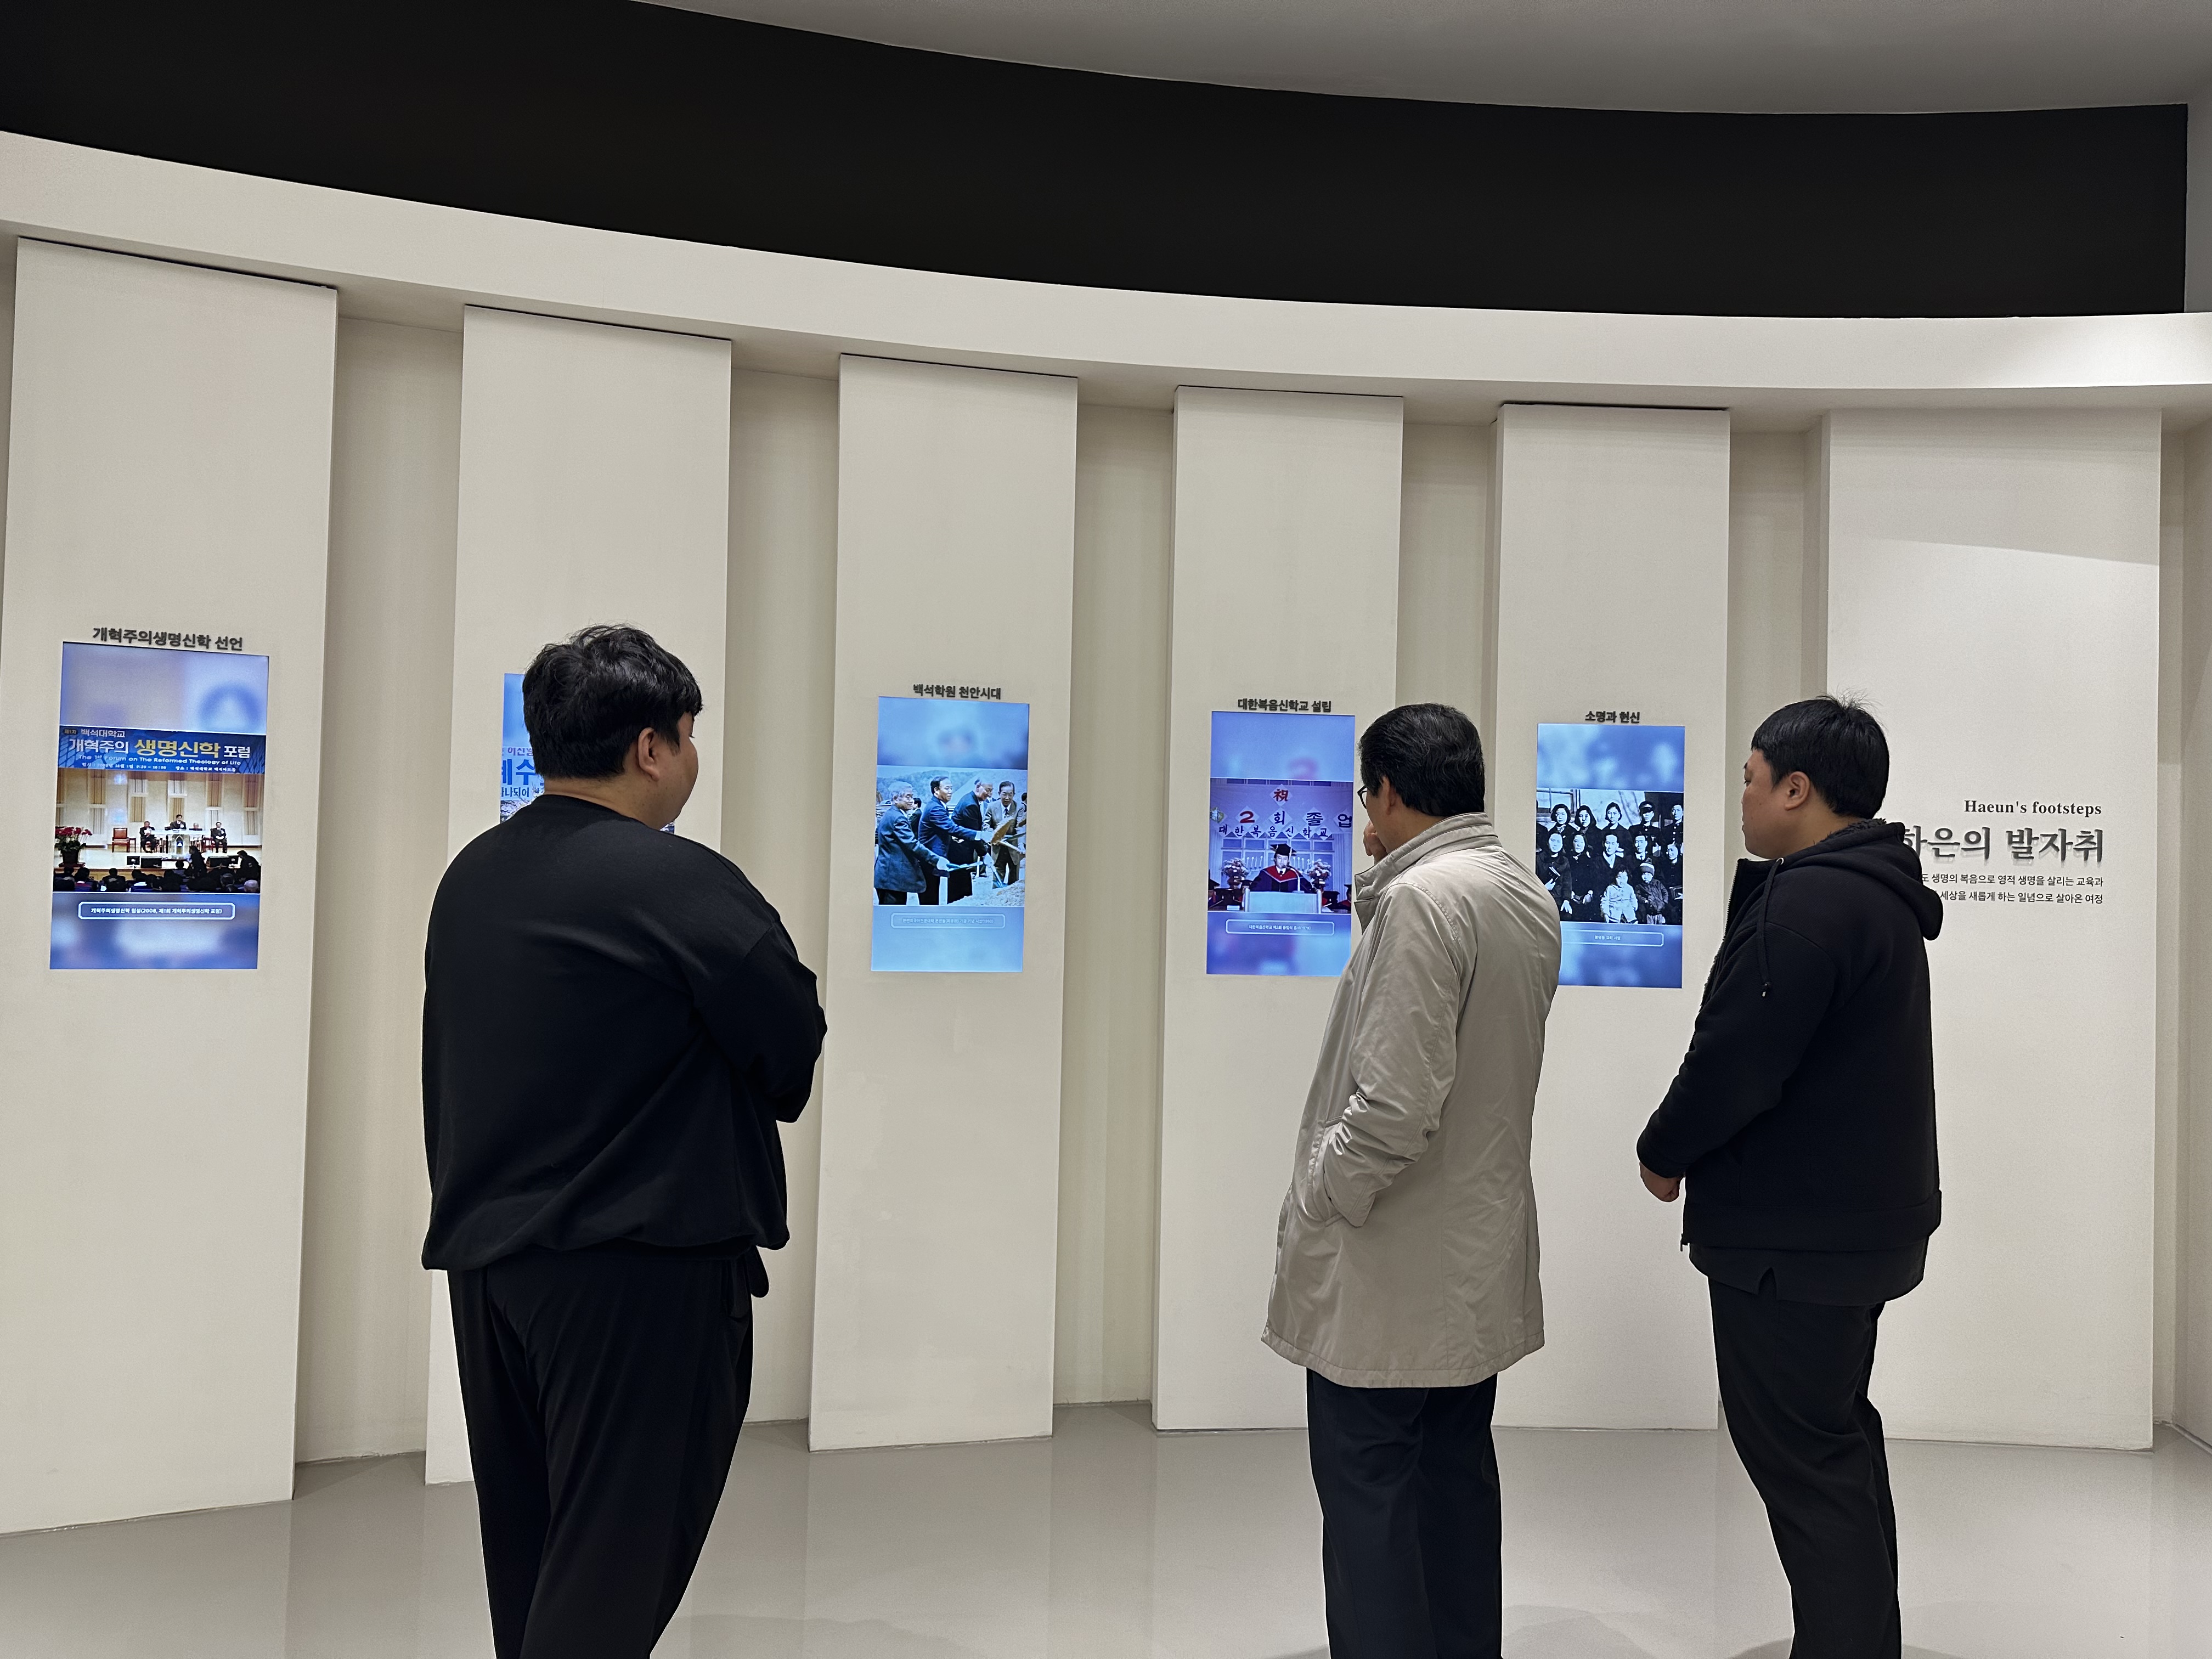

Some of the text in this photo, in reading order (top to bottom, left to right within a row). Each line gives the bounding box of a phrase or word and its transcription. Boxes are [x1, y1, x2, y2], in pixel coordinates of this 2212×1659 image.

[93, 627, 242, 651] 개혁주의생명신학 선언
[913, 684, 1001, 699] 백석학원 천안시대
[1238, 698, 1332, 713] 대한복음신학교 설립
[1585, 710, 1640, 724] 소명과 헌신
[81, 729, 126, 738] 백석대학교
[69, 738, 251, 758] 개혁주의 생명신학 포럼
[1273, 789, 1289, 802] 祝
[1964, 800, 2102, 817] Haeun's footsteps
[2005, 827, 2103, 862] 발자취
[1931, 873, 1957, 883] 생명의
[1960, 874, 1995, 884] 복음으로
[1997, 875, 2015, 885] 영적
[2018, 876, 2045, 885] 생명을
[2047, 876, 2074, 886] 살리는
[2076, 877, 2103, 887] 교육과
[1940, 890, 2103, 904] 세상을 새롭게 하는 일념으로 살아온 여정
